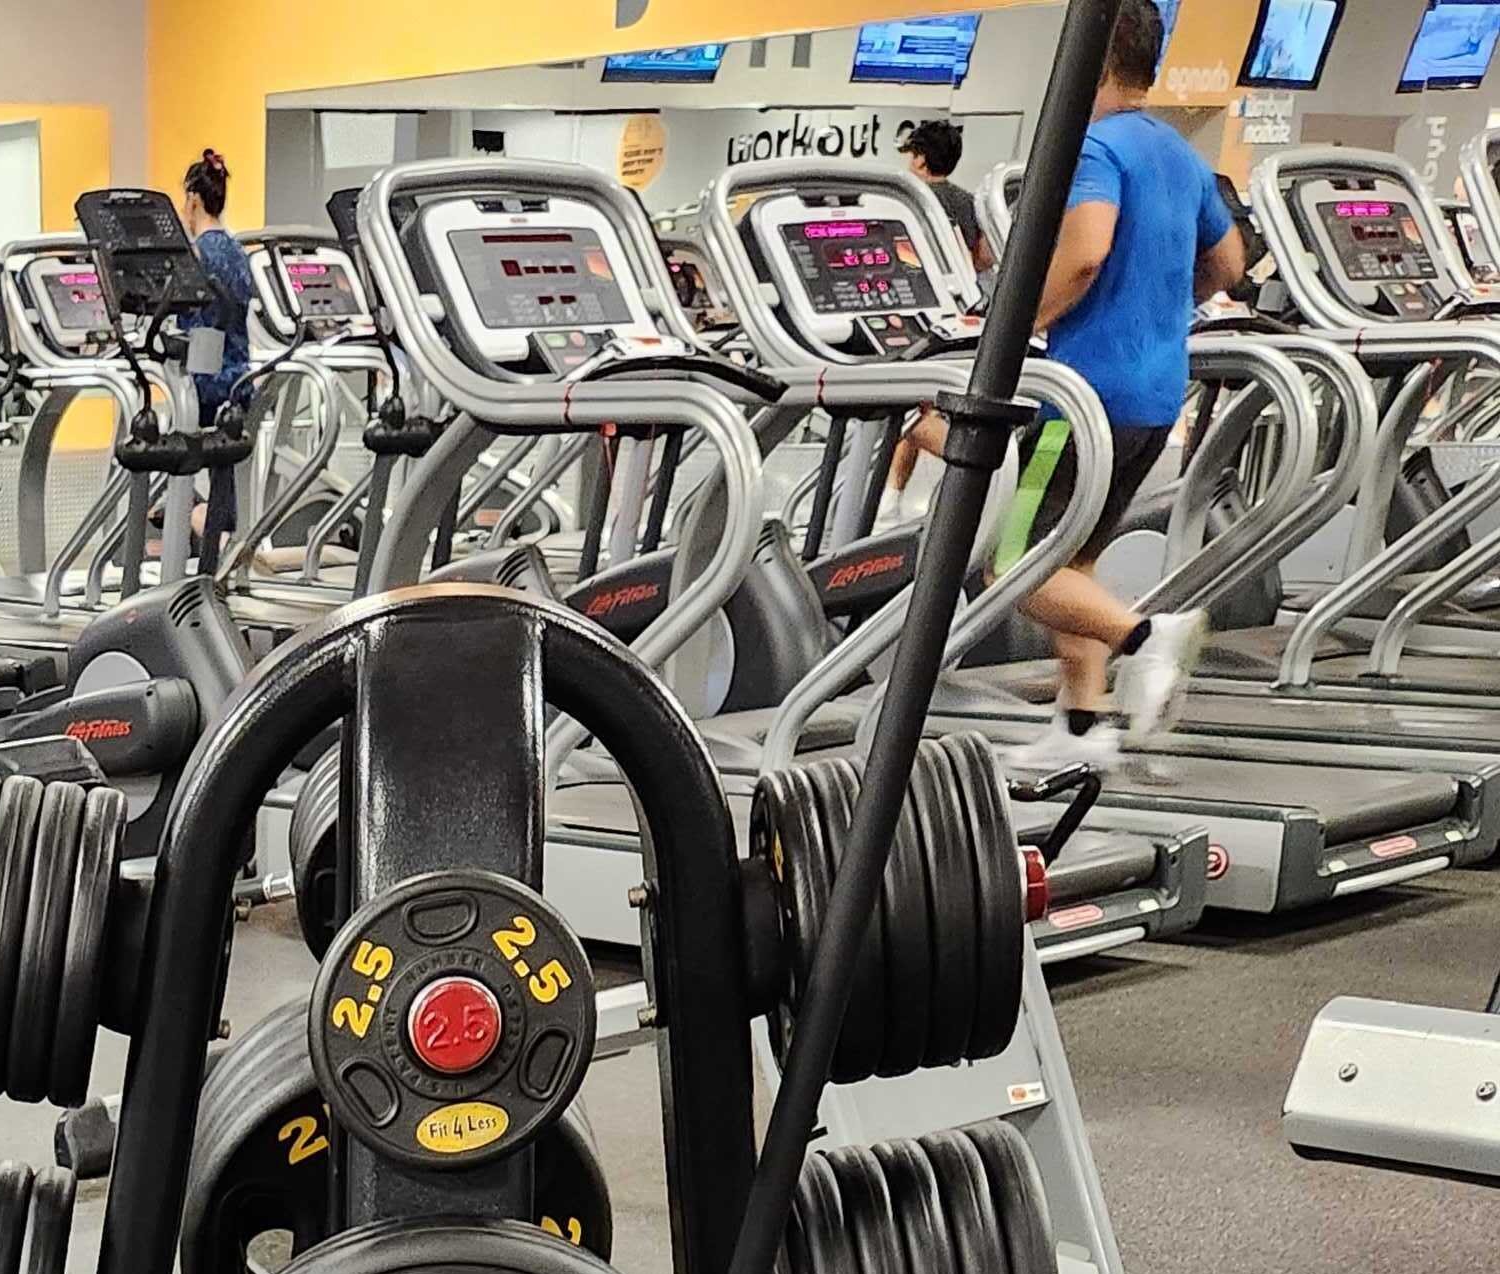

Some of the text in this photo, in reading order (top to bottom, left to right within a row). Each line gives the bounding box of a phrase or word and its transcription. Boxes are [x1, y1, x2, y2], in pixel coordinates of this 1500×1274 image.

[727, 113, 881, 166] workout
[491, 916, 572, 1004] 2.5
[331, 941, 395, 1038] 2.5
[424, 1005, 490, 1048] 2.5
[429, 1115, 497, 1139] Fit 4 Less
